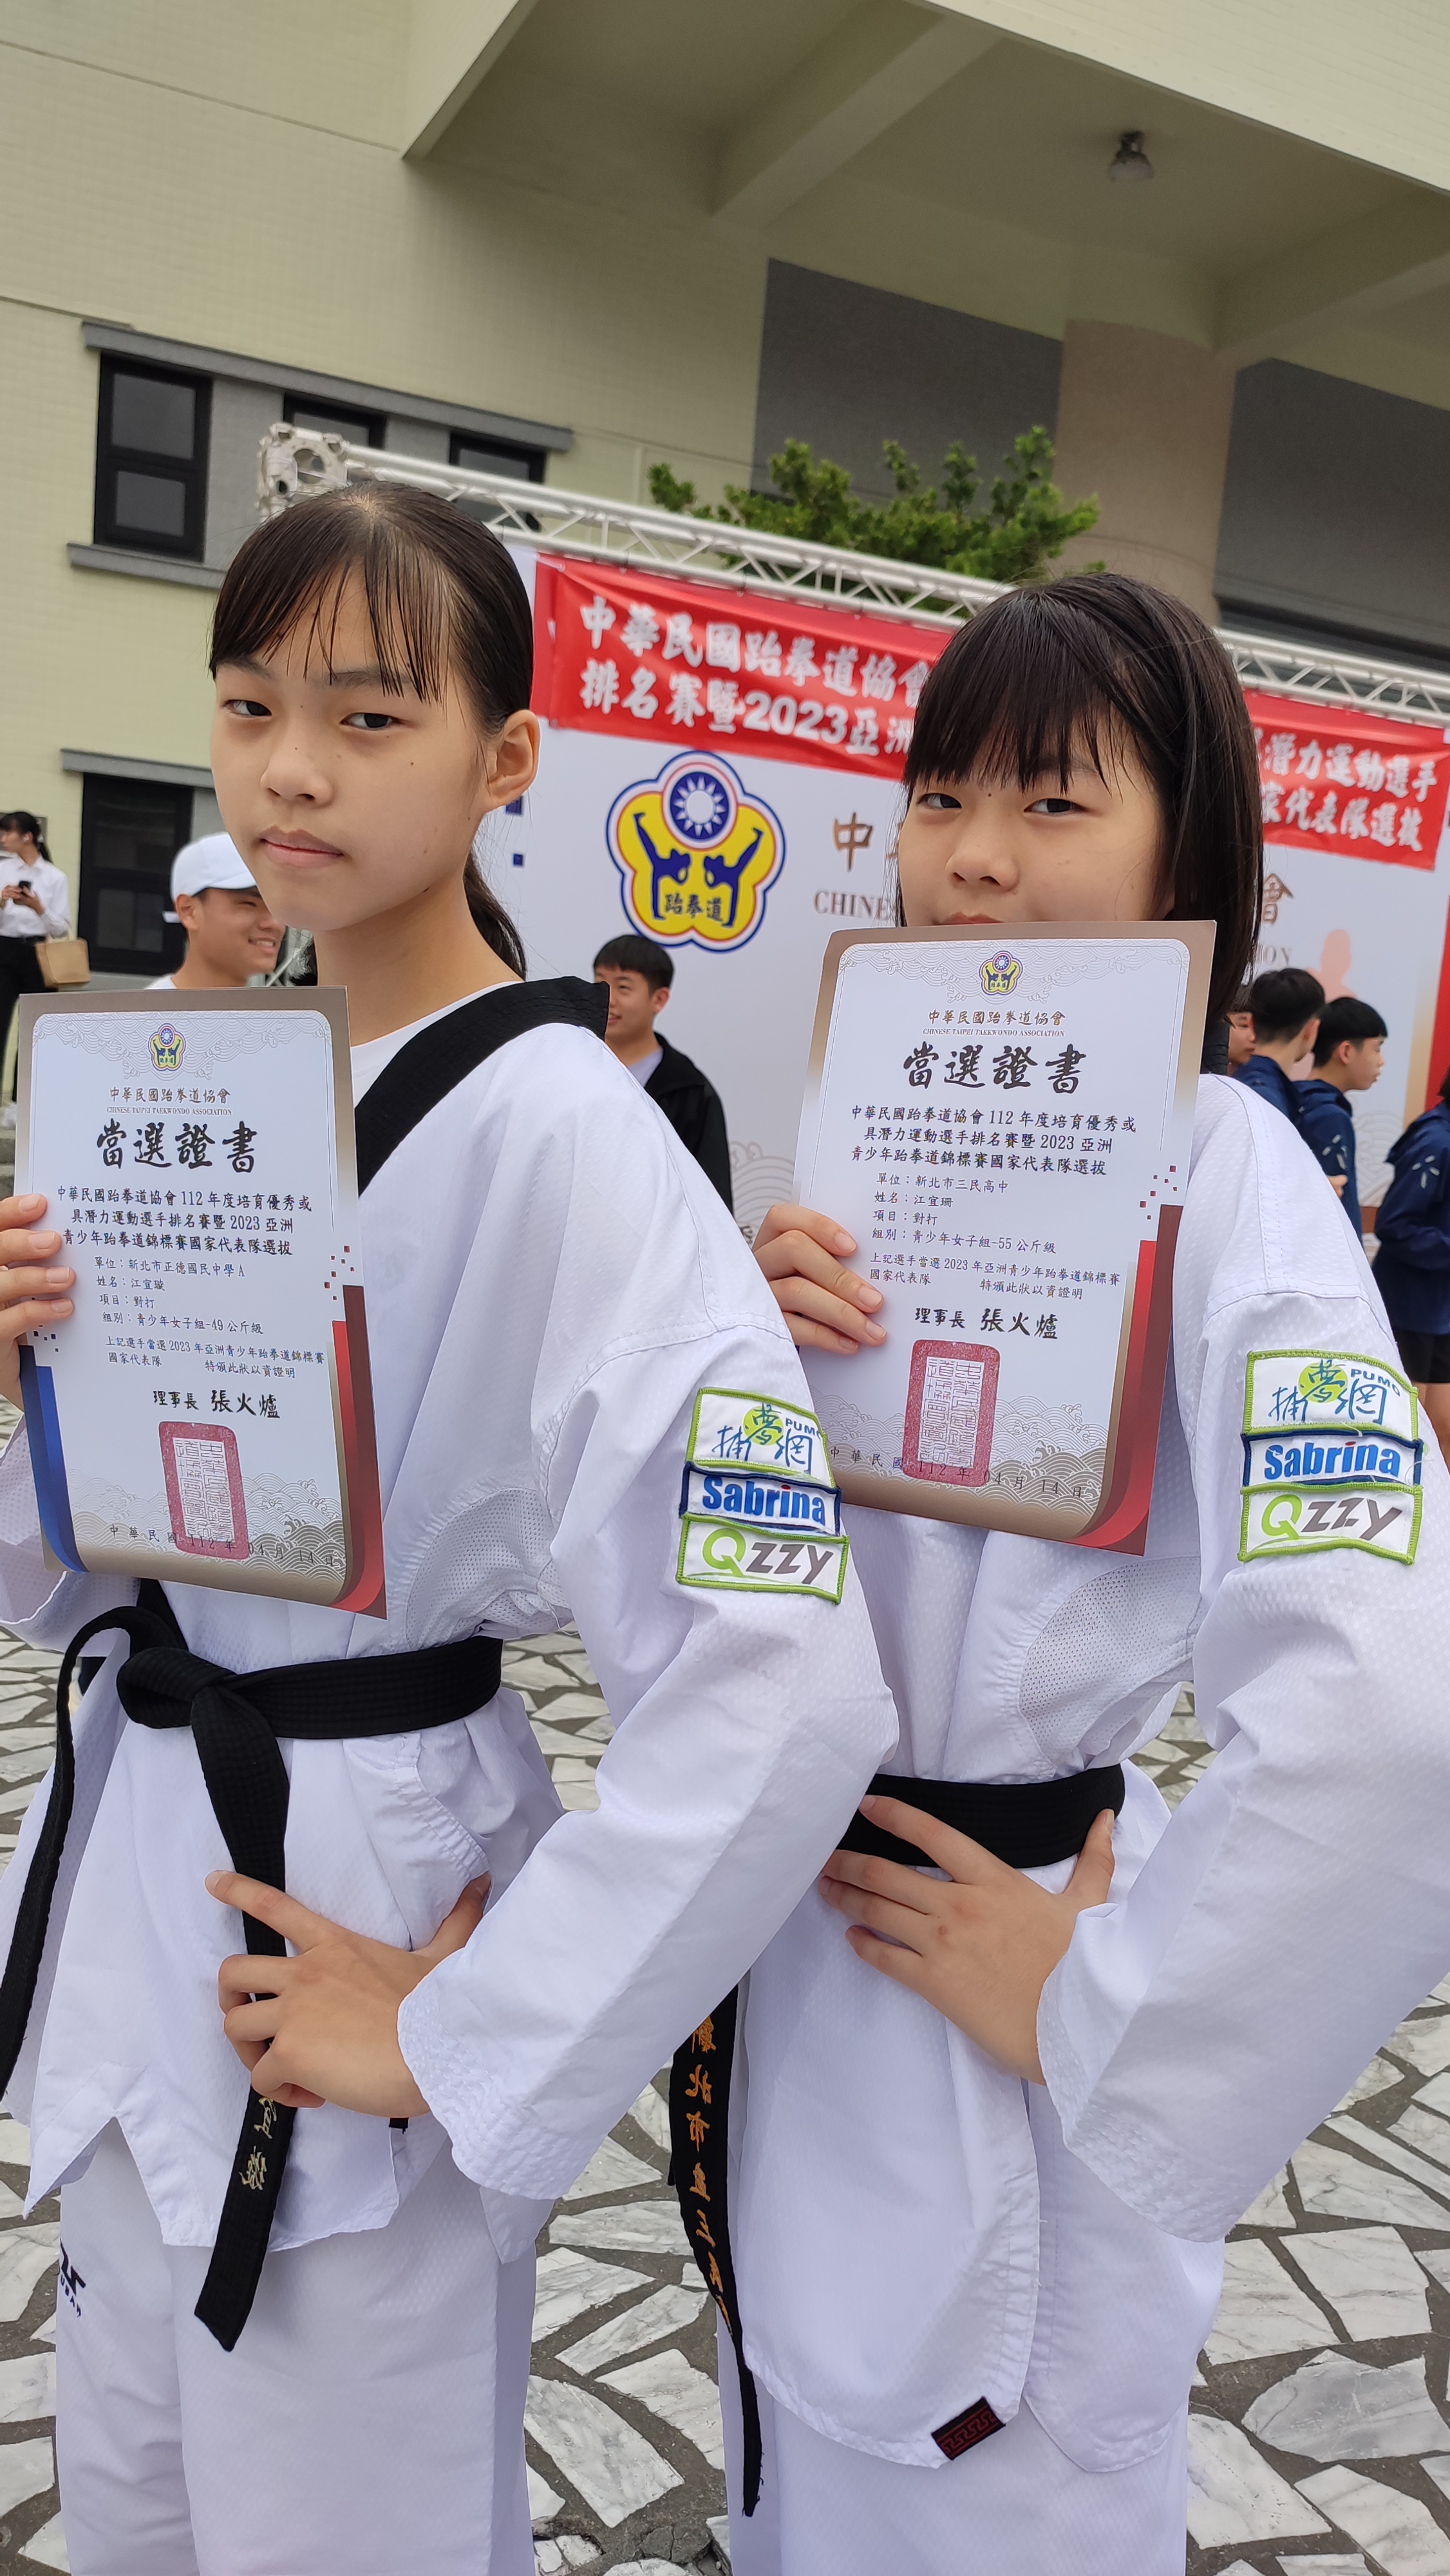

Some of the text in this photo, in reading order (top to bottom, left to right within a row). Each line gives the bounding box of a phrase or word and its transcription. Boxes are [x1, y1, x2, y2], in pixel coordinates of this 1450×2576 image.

[580, 596, 930, 708] 中華民國跆拳道協會
[1261, 727, 1436, 802] 潛力運動選手
[833, 811, 873, 871] 中
[813, 890, 892, 921] CHINE
[928, 1009, 1066, 1026] 中華民國跆拳道協會
[903, 1041, 1086, 1094] 當選證書
[109, 1086, 231, 1104] 中華民國跆拳道協會
[193, 1108, 232, 1116] ASSOCIATION
[97, 1118, 257, 1173] 當選證書
[851, 1145, 1107, 1175] 青少年跆拳道錦標賽國家代表隊選拔
[62, 1228, 293, 1255] 青少年跆拳道錦標賽國家代表隊選拔
[870, 1269, 932, 1285] 國家代表隊
[108, 1352, 163, 1367] 國家代表隊
[1264, 1441, 1400, 1480] Sabrina
[702, 1475, 825, 1526] Sabrina
